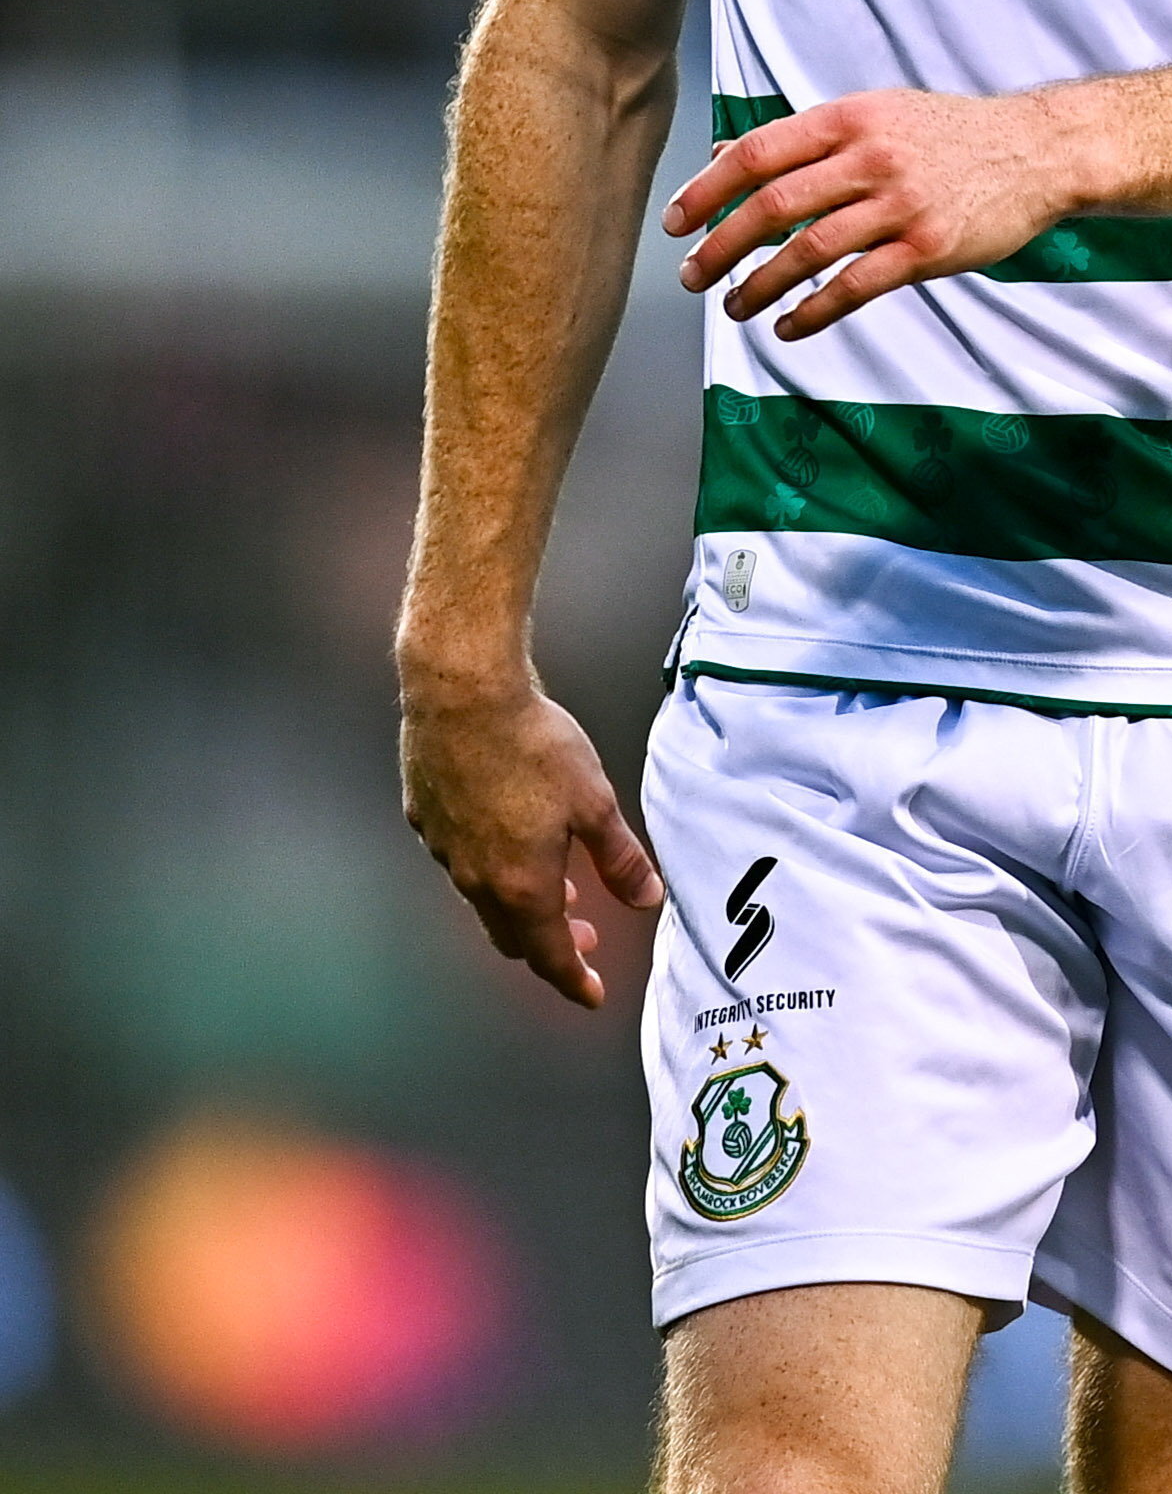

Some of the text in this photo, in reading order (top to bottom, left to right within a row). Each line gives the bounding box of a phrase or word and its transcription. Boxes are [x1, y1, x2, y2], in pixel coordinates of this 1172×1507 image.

[694, 989, 836, 1034] INTEGRITY SECURITY
[687, 1170, 738, 1210] SHAMROCK
[739, 1165, 785, 1206] ROVERS
